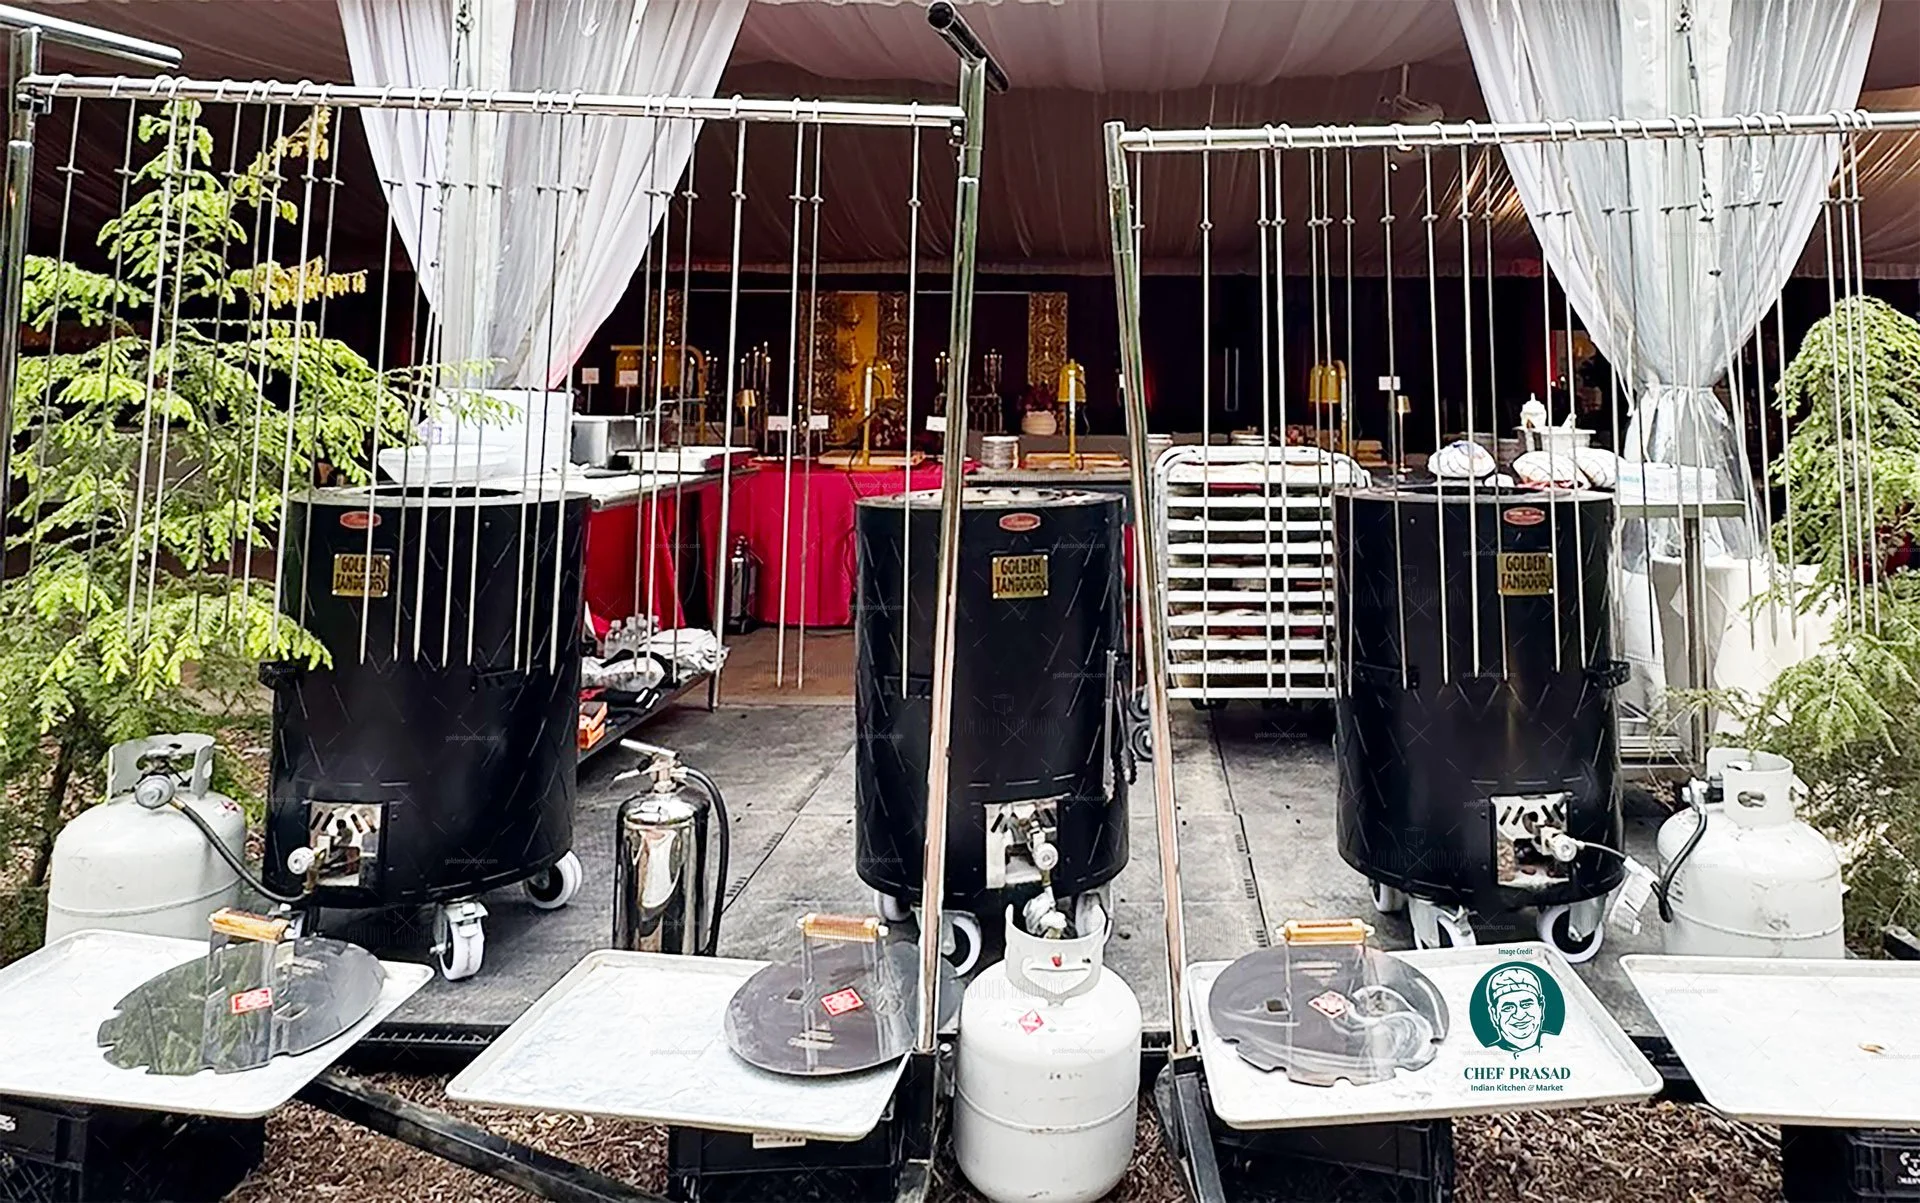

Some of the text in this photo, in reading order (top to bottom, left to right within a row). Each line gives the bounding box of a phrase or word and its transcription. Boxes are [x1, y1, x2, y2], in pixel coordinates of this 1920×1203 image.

[1001, 558, 1041, 575] GOLDEN
[1505, 555, 1546, 572] GOLDEN
[995, 575, 1047, 593] TANDOORS
